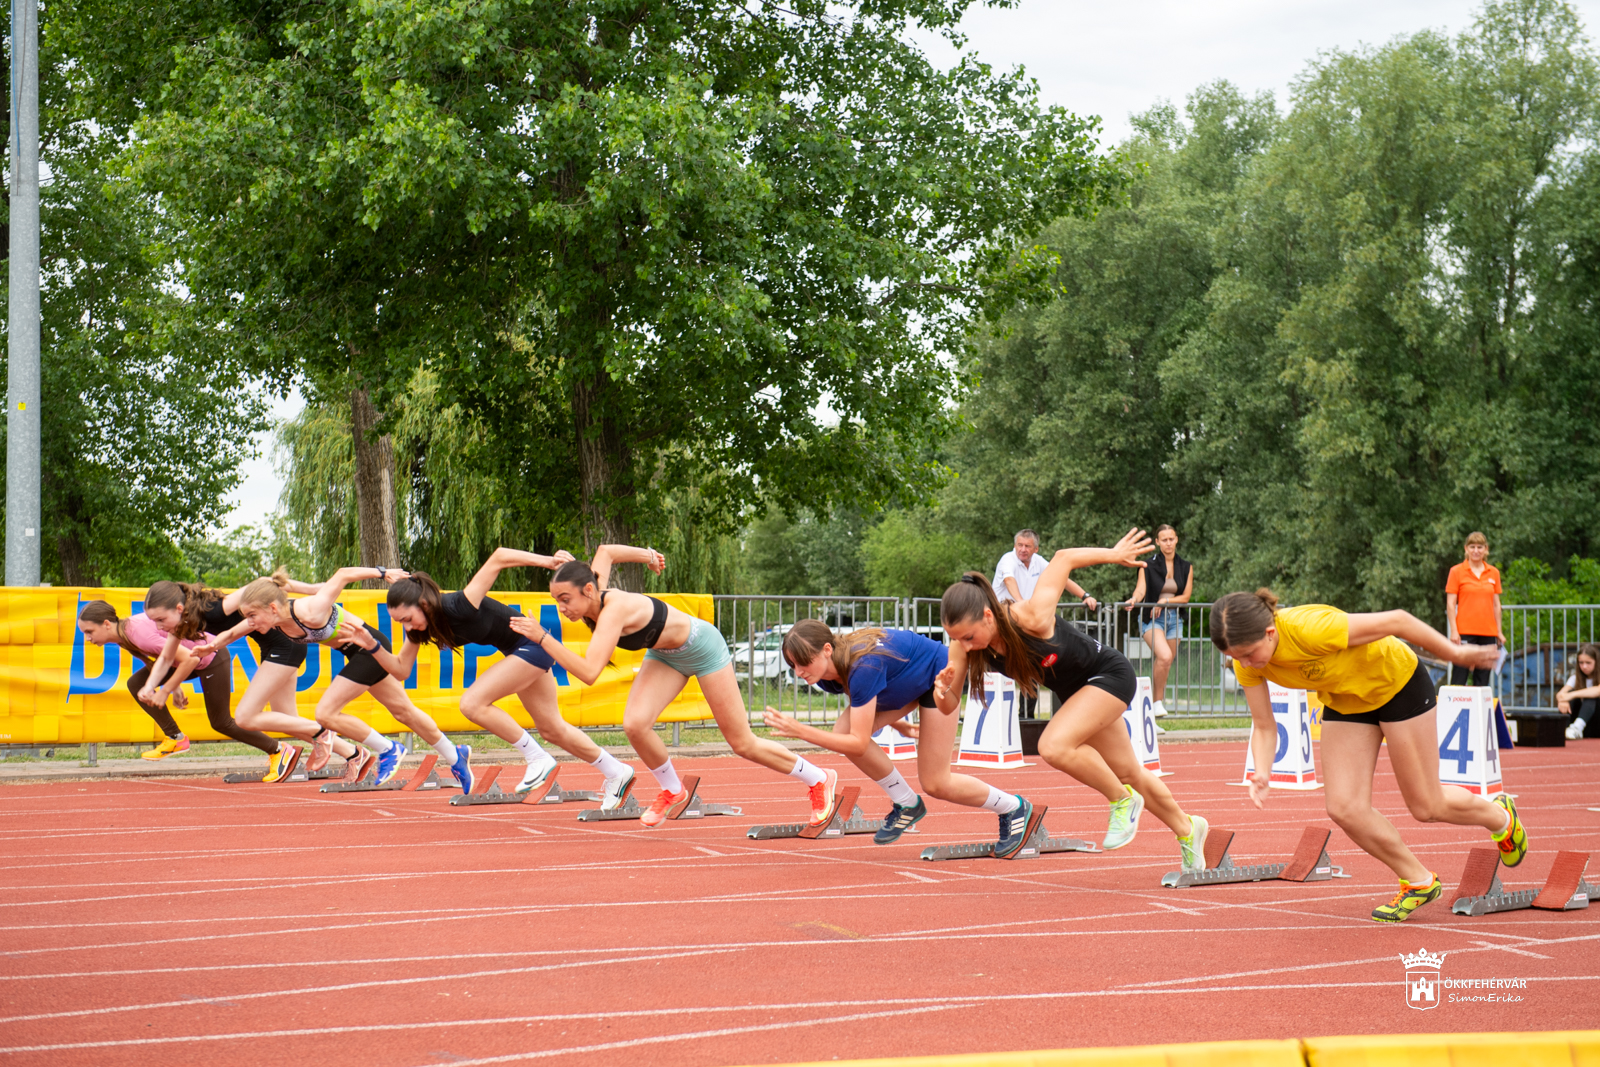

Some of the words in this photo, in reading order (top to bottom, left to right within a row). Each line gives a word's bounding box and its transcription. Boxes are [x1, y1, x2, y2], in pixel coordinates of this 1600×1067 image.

[687, 618, 700, 646] PRO
[970, 690, 996, 745] 7
[1002, 690, 1015, 746] 7
[1142, 695, 1155, 754] 6
[1299, 701, 1311, 764] 5
[1438, 708, 1474, 774] 4
[1485, 707, 1498, 774] 4
